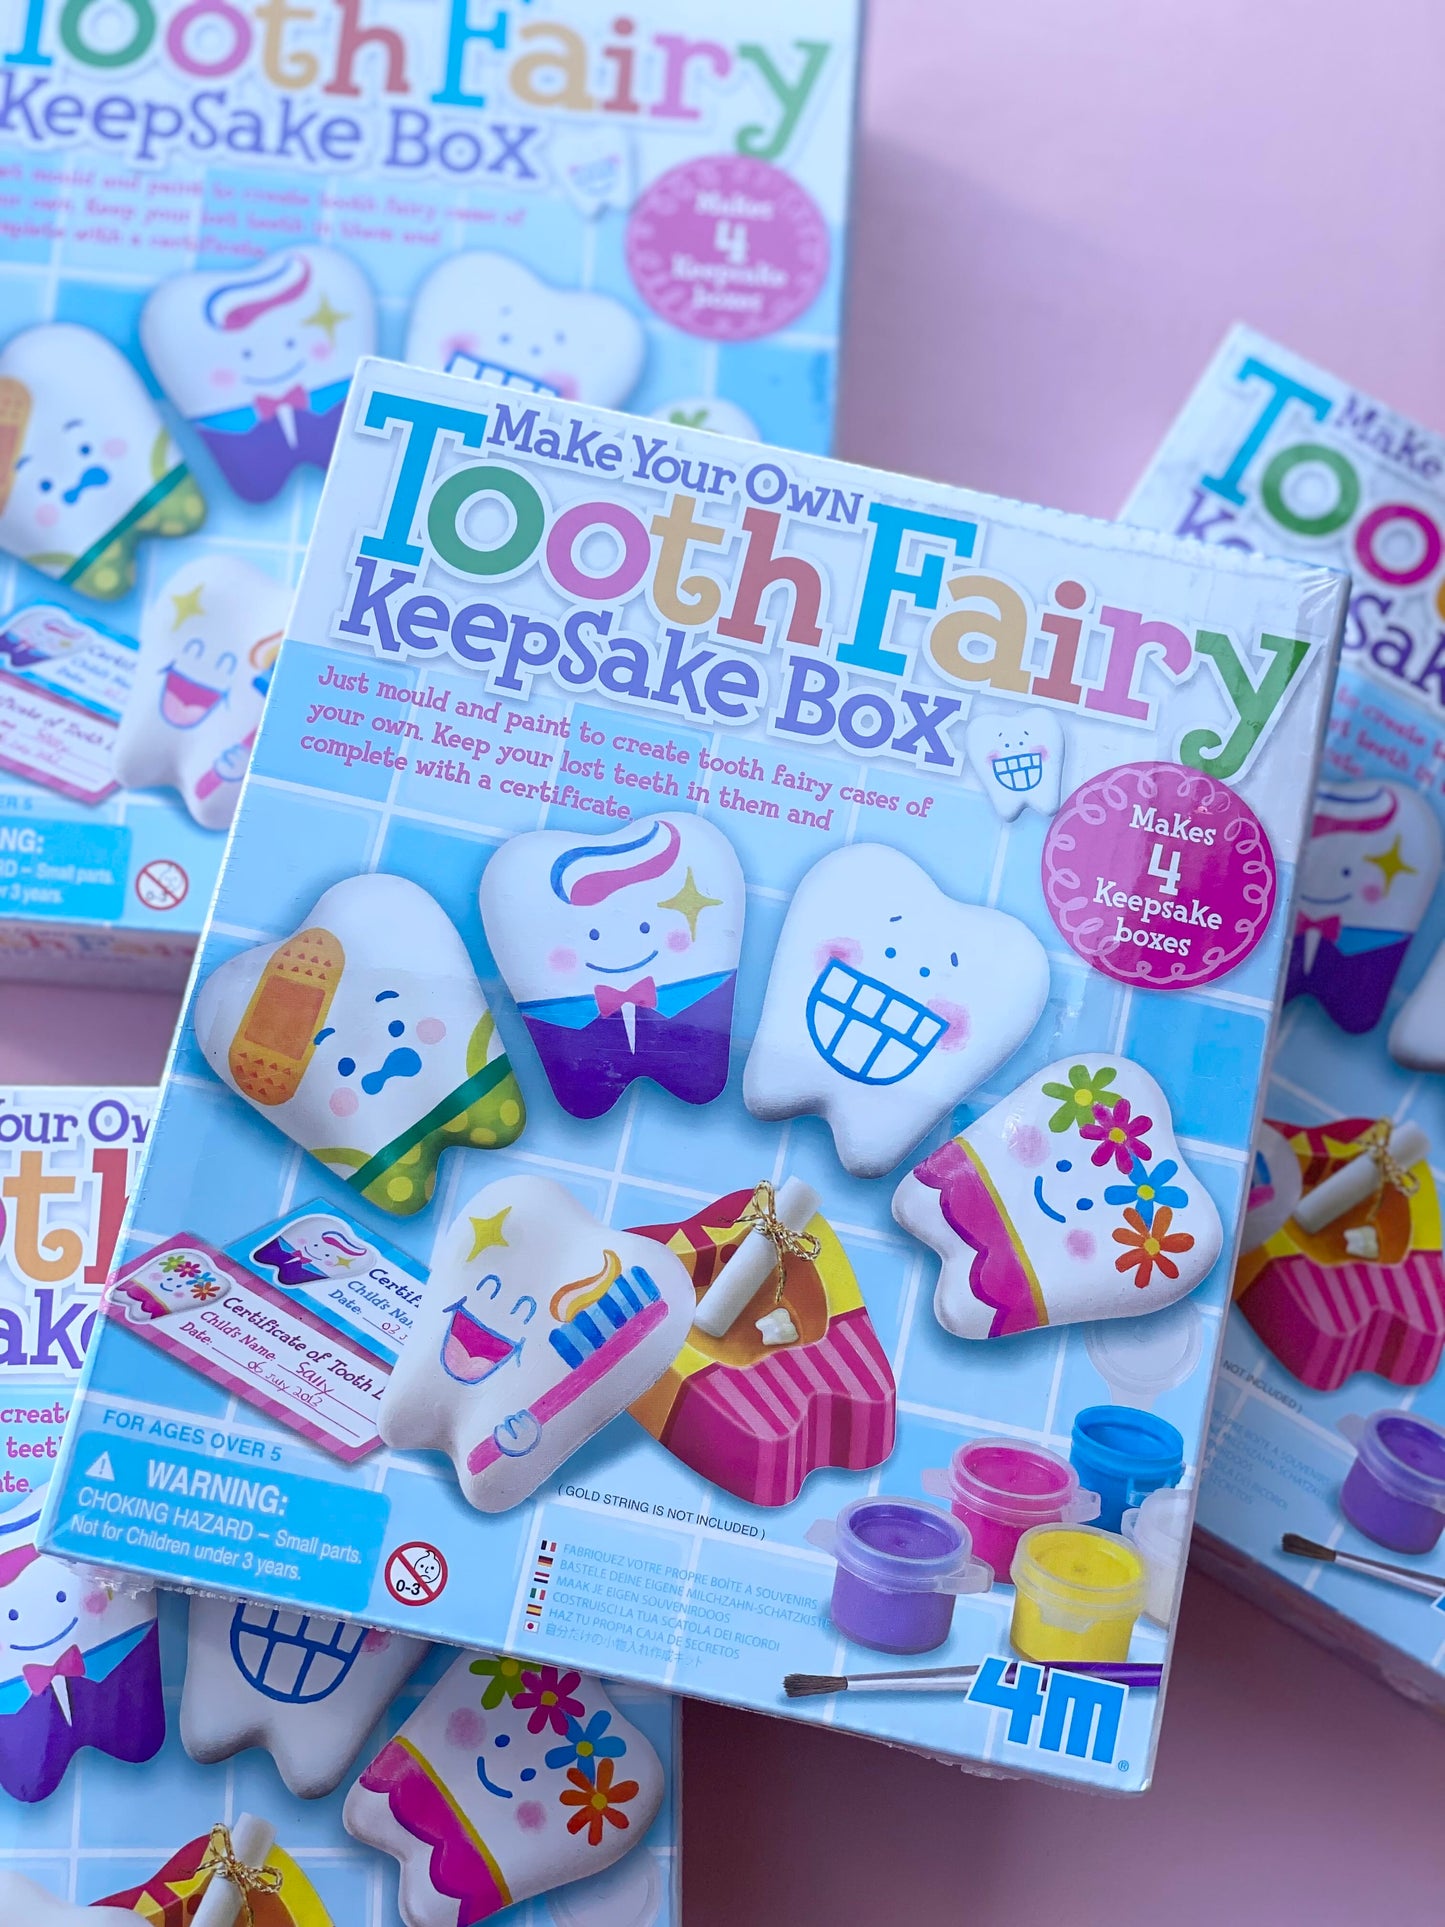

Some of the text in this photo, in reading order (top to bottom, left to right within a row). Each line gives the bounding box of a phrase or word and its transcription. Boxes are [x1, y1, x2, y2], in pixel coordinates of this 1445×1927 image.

[430, 0, 831, 162] Fairy
[384, 107, 540, 180] Box
[486, 404, 622, 472] Make
[632, 434, 736, 496] Your
[359, 391, 1312, 779] Tooth Fairy
[774, 655, 963, 768] Box
[306, 703, 835, 831] your own. Keep your lost teeth in them and
[318, 665, 935, 818] Just mould and paint to create tooth fairy cases of
[300, 734, 635, 822] complete with a certificate.
[1129, 804, 1217, 847] Makes
[1147, 843, 1182, 896] 4
[1092, 877, 1223, 930] Keepsake
[1113, 917, 1192, 957] boxes
[0, 1113, 78, 1144] our
[328, 1289, 362, 1315] Date:
[347, 1280, 391, 1311] Child's
[179, 1321, 213, 1346] Date:
[200, 1310, 242, 1340] Child's
[239, 1334, 277, 1361] Name:
[223, 1297, 307, 1352] Certificate
[306, 1349, 333, 1364] of
[327, 1359, 375, 1393] Tooth
[6, 1436, 63, 1458] teet
[102, 1409, 282, 1462] FOR AGES OVER 5
[146, 1458, 290, 1517] WARNING:
[565, 1485, 601, 1502] GOLD
[603, 1493, 650, 1513] STRING
[652, 1504, 665, 1517] IS
[666, 1508, 694, 1524] NOT
[696, 1514, 759, 1538] INCLUDED
[70, 1514, 303, 1582] Not for Children under 3 years.
[78, 1486, 170, 1525] CHOKING
[172, 1507, 253, 1542] HAZARD
[275, 1529, 318, 1556] Small
[320, 1542, 362, 1565] parts.
[395, 1578, 422, 1597] 0-3
[556, 1575, 731, 1624] MAAK JE EIGEN SOUVENIRDOOS
[560, 1559, 607, 1579] BASTELE
[609, 1570, 645, 1587] DEINE
[645, 1578, 684, 1597] EIGENE
[563, 1543, 626, 1566] FABRIQUEZ
[627, 1558, 663, 1575] VOTRE
[664, 1566, 709, 1585] PROPRE
[755, 1586, 818, 1610] SOUVENIRS
[549, 1608, 740, 1660] HAZ TU PROPIA CAJA DE SECRETOS
[552, 1591, 781, 1651] COSTRUISCI LA TUA SCATOLA DEI RICORDI
